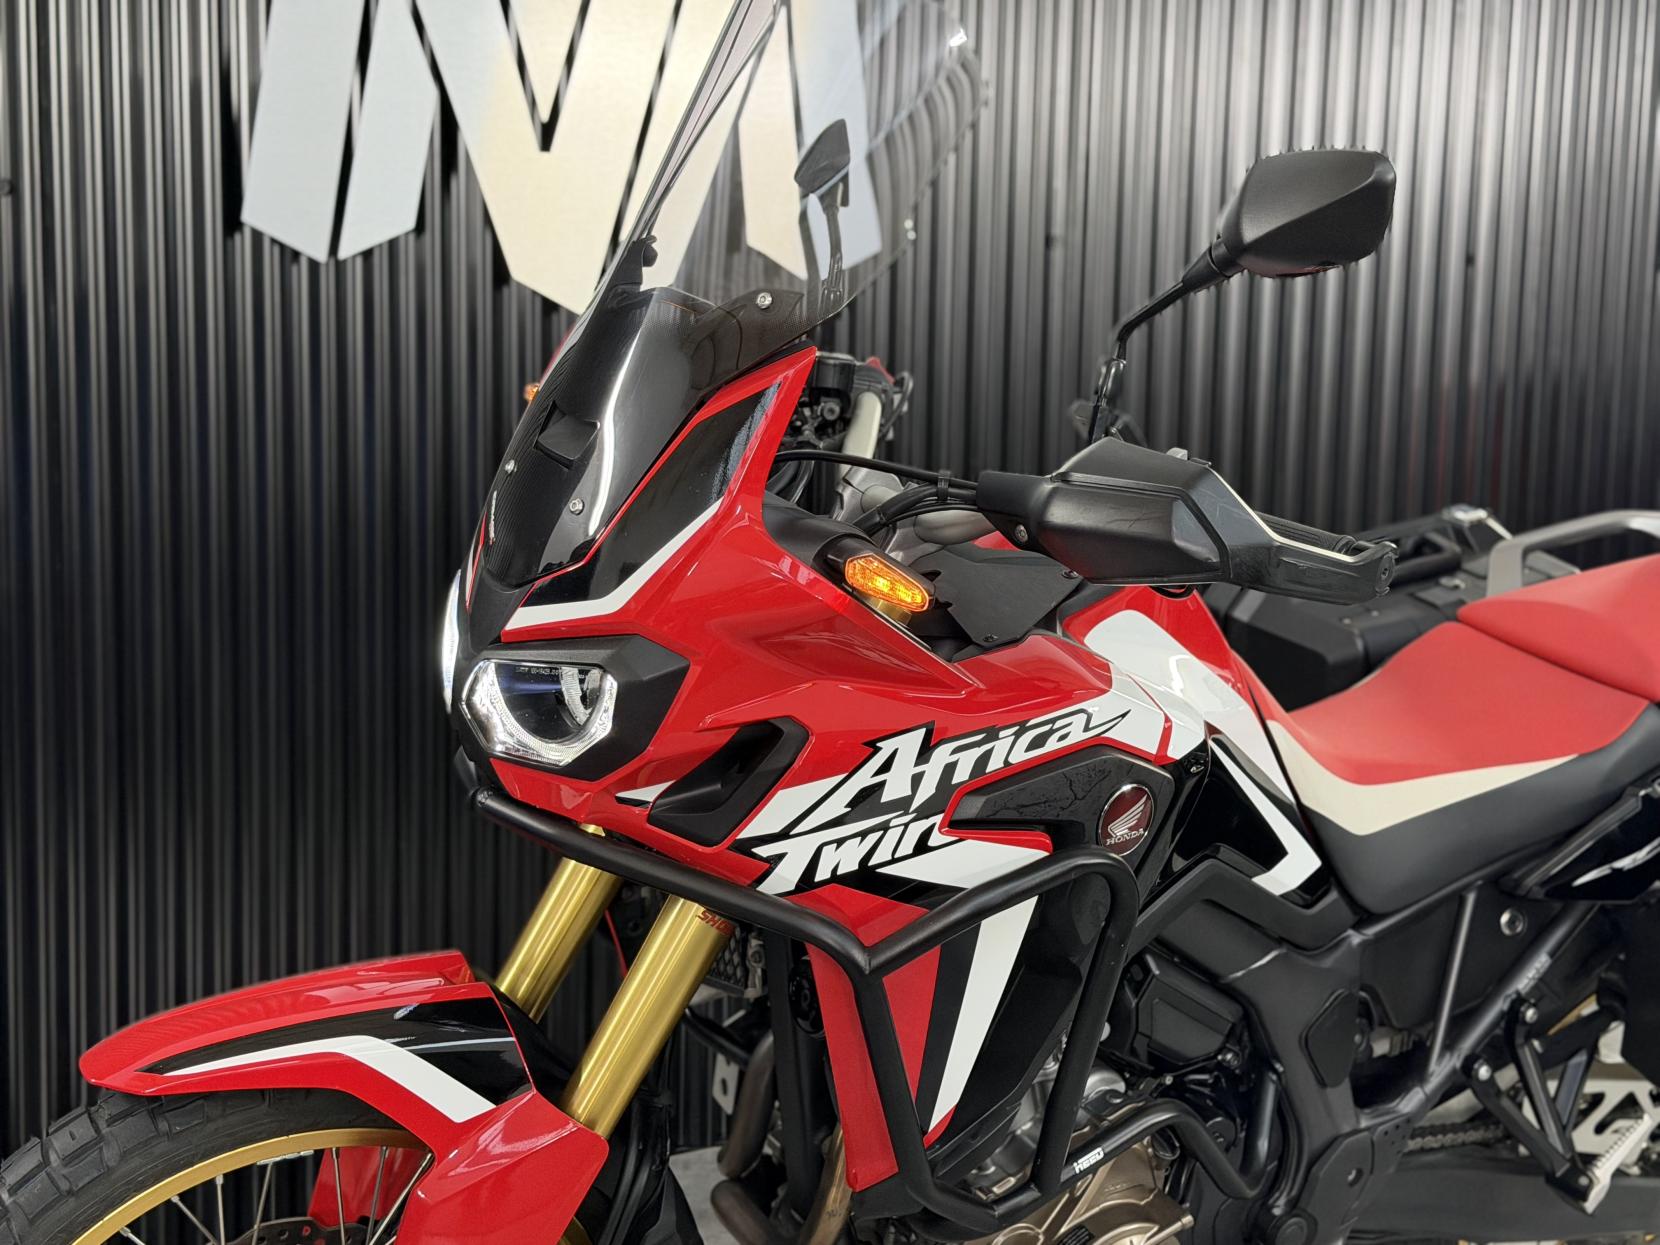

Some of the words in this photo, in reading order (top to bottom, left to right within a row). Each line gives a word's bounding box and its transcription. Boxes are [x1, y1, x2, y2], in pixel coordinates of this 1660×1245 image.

[790, 709, 1131, 834] Africa
[752, 811, 962, 895] Twin
[1105, 828, 1145, 846] HONDA
